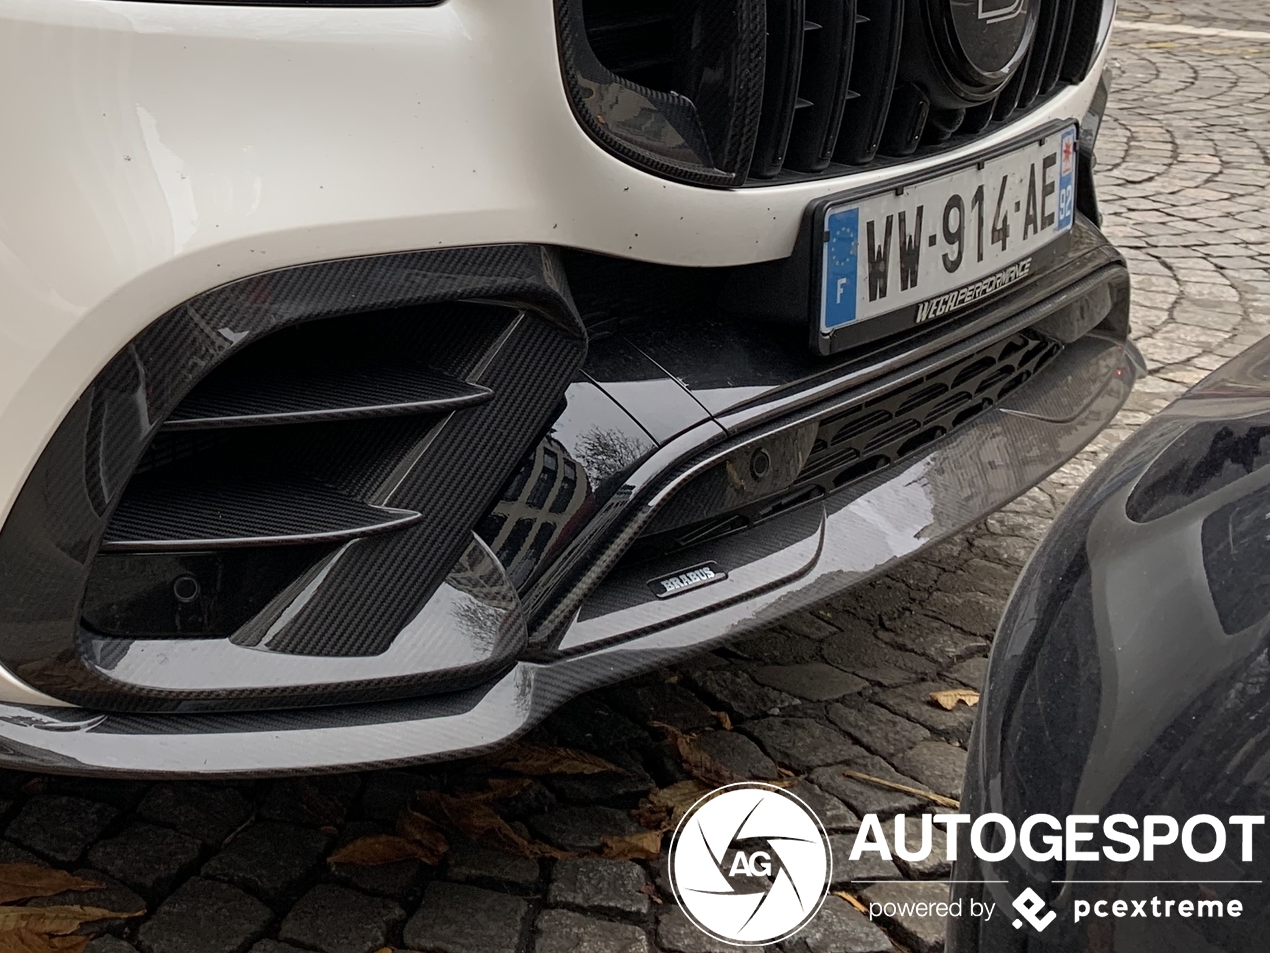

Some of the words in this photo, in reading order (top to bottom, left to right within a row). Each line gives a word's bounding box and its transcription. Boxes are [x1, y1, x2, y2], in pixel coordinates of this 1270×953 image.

[1058, 184, 1073, 218] 92
[866, 151, 1058, 303] WW-914-AE
[835, 277, 847, 305] F
[660, 566, 716, 592] BRABUS
